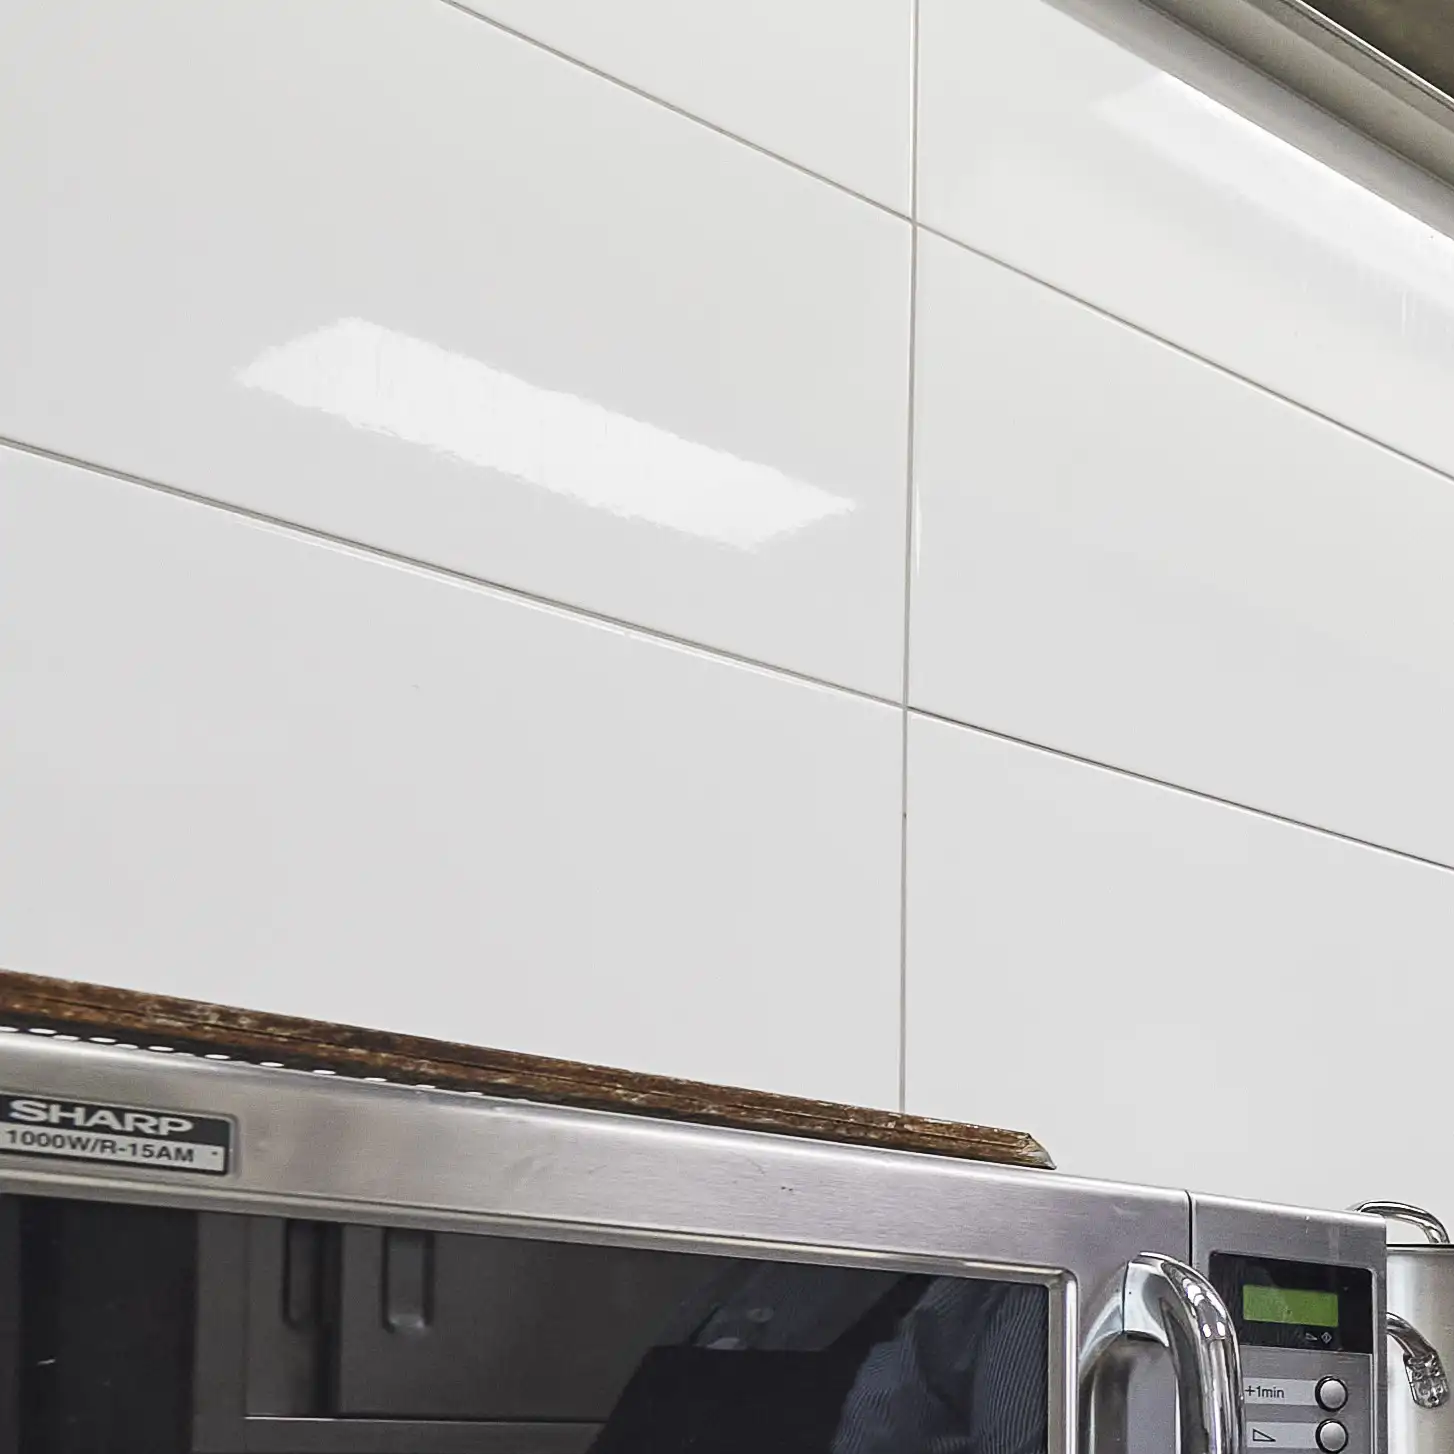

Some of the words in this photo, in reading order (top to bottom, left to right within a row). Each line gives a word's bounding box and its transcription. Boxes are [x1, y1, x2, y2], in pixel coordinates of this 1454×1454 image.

[8, 1099, 194, 1136] SHARP
[7, 1129, 195, 1163] 1000W/R-15AM
[1244, 1384, 1286, 1400] +1min
